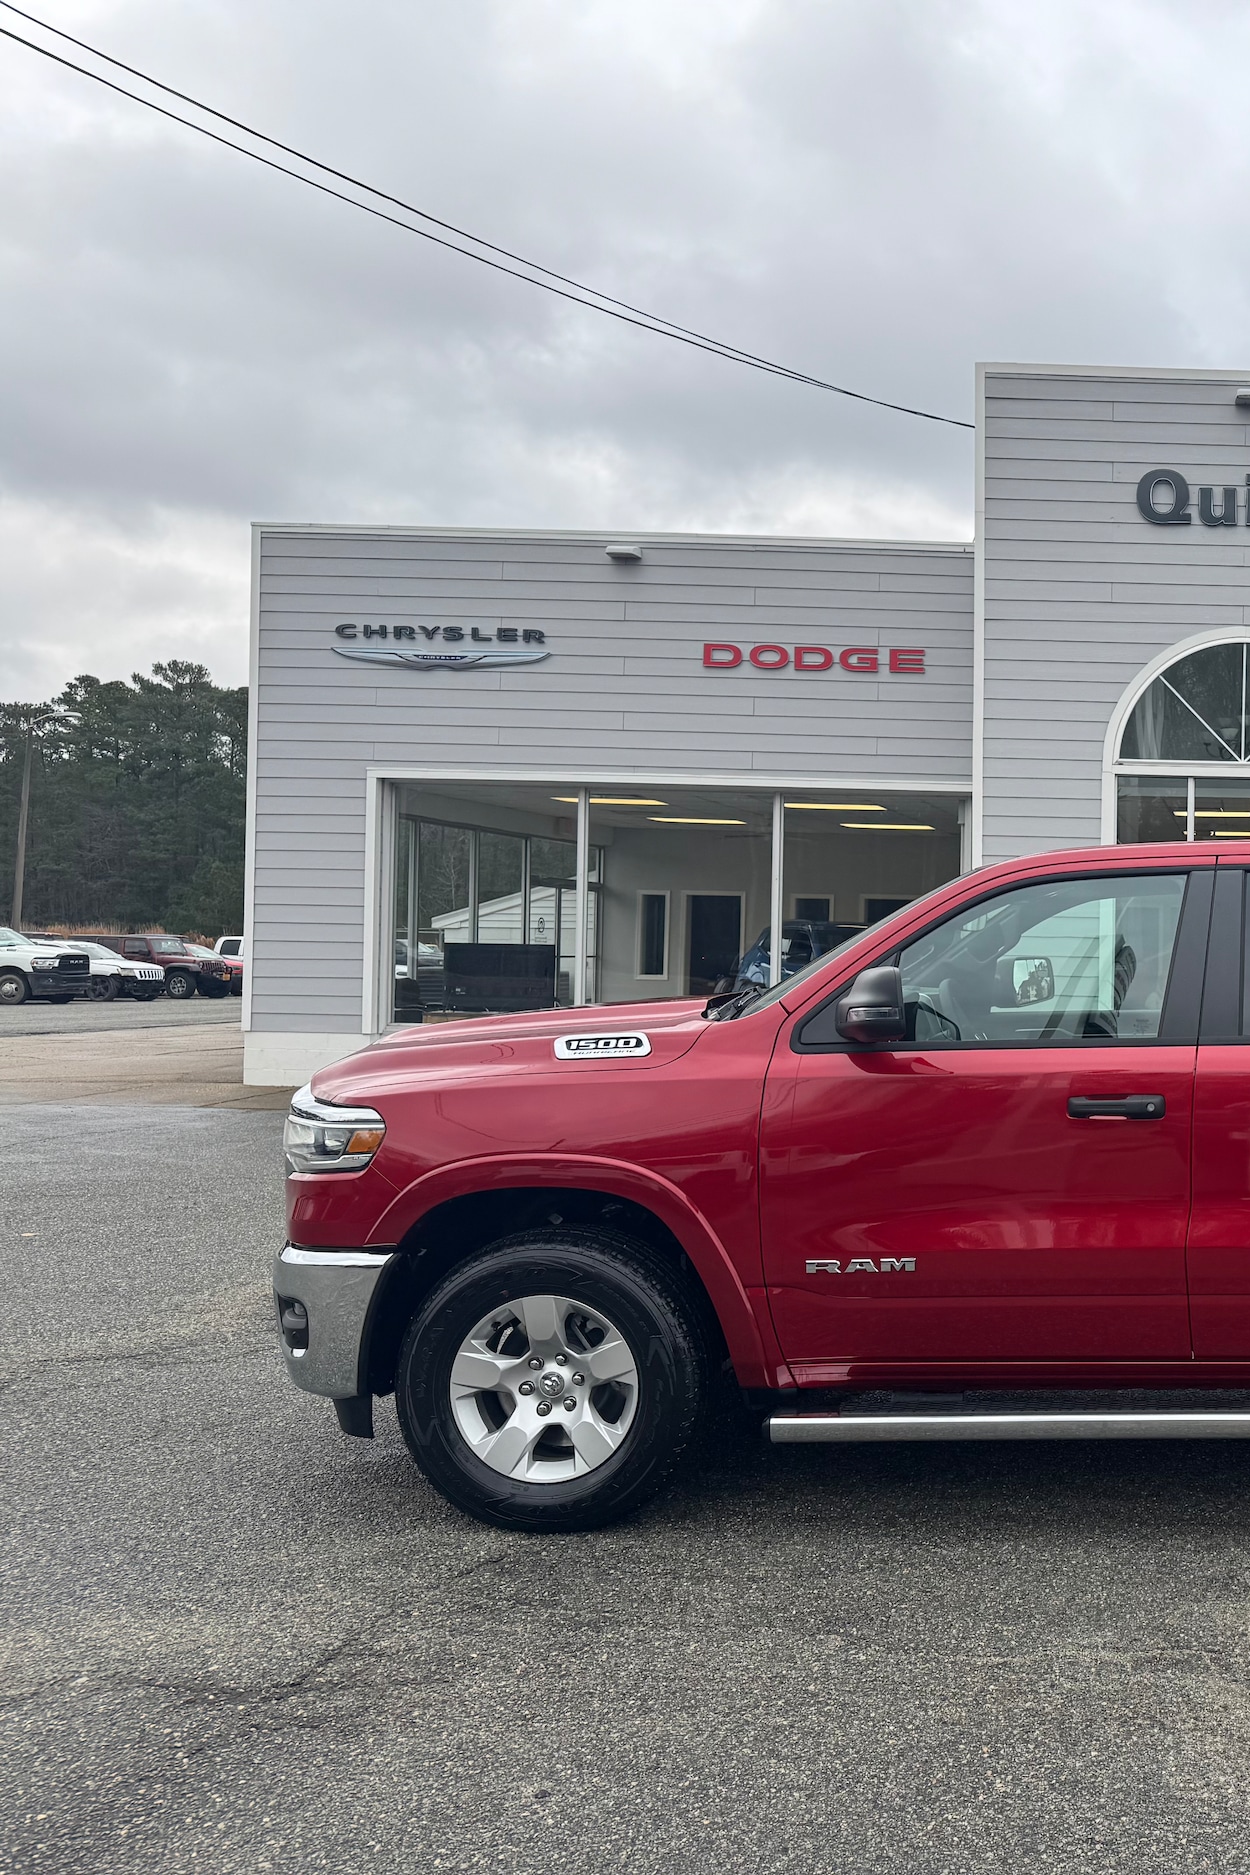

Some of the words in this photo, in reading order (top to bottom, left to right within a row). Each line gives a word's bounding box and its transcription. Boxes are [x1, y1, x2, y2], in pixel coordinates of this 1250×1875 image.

[335, 623, 546, 644] CHRYSLER
[703, 643, 926, 674] DODGE
[569, 1038, 637, 1049] 1500
[805, 1258, 916, 1273] RAM
